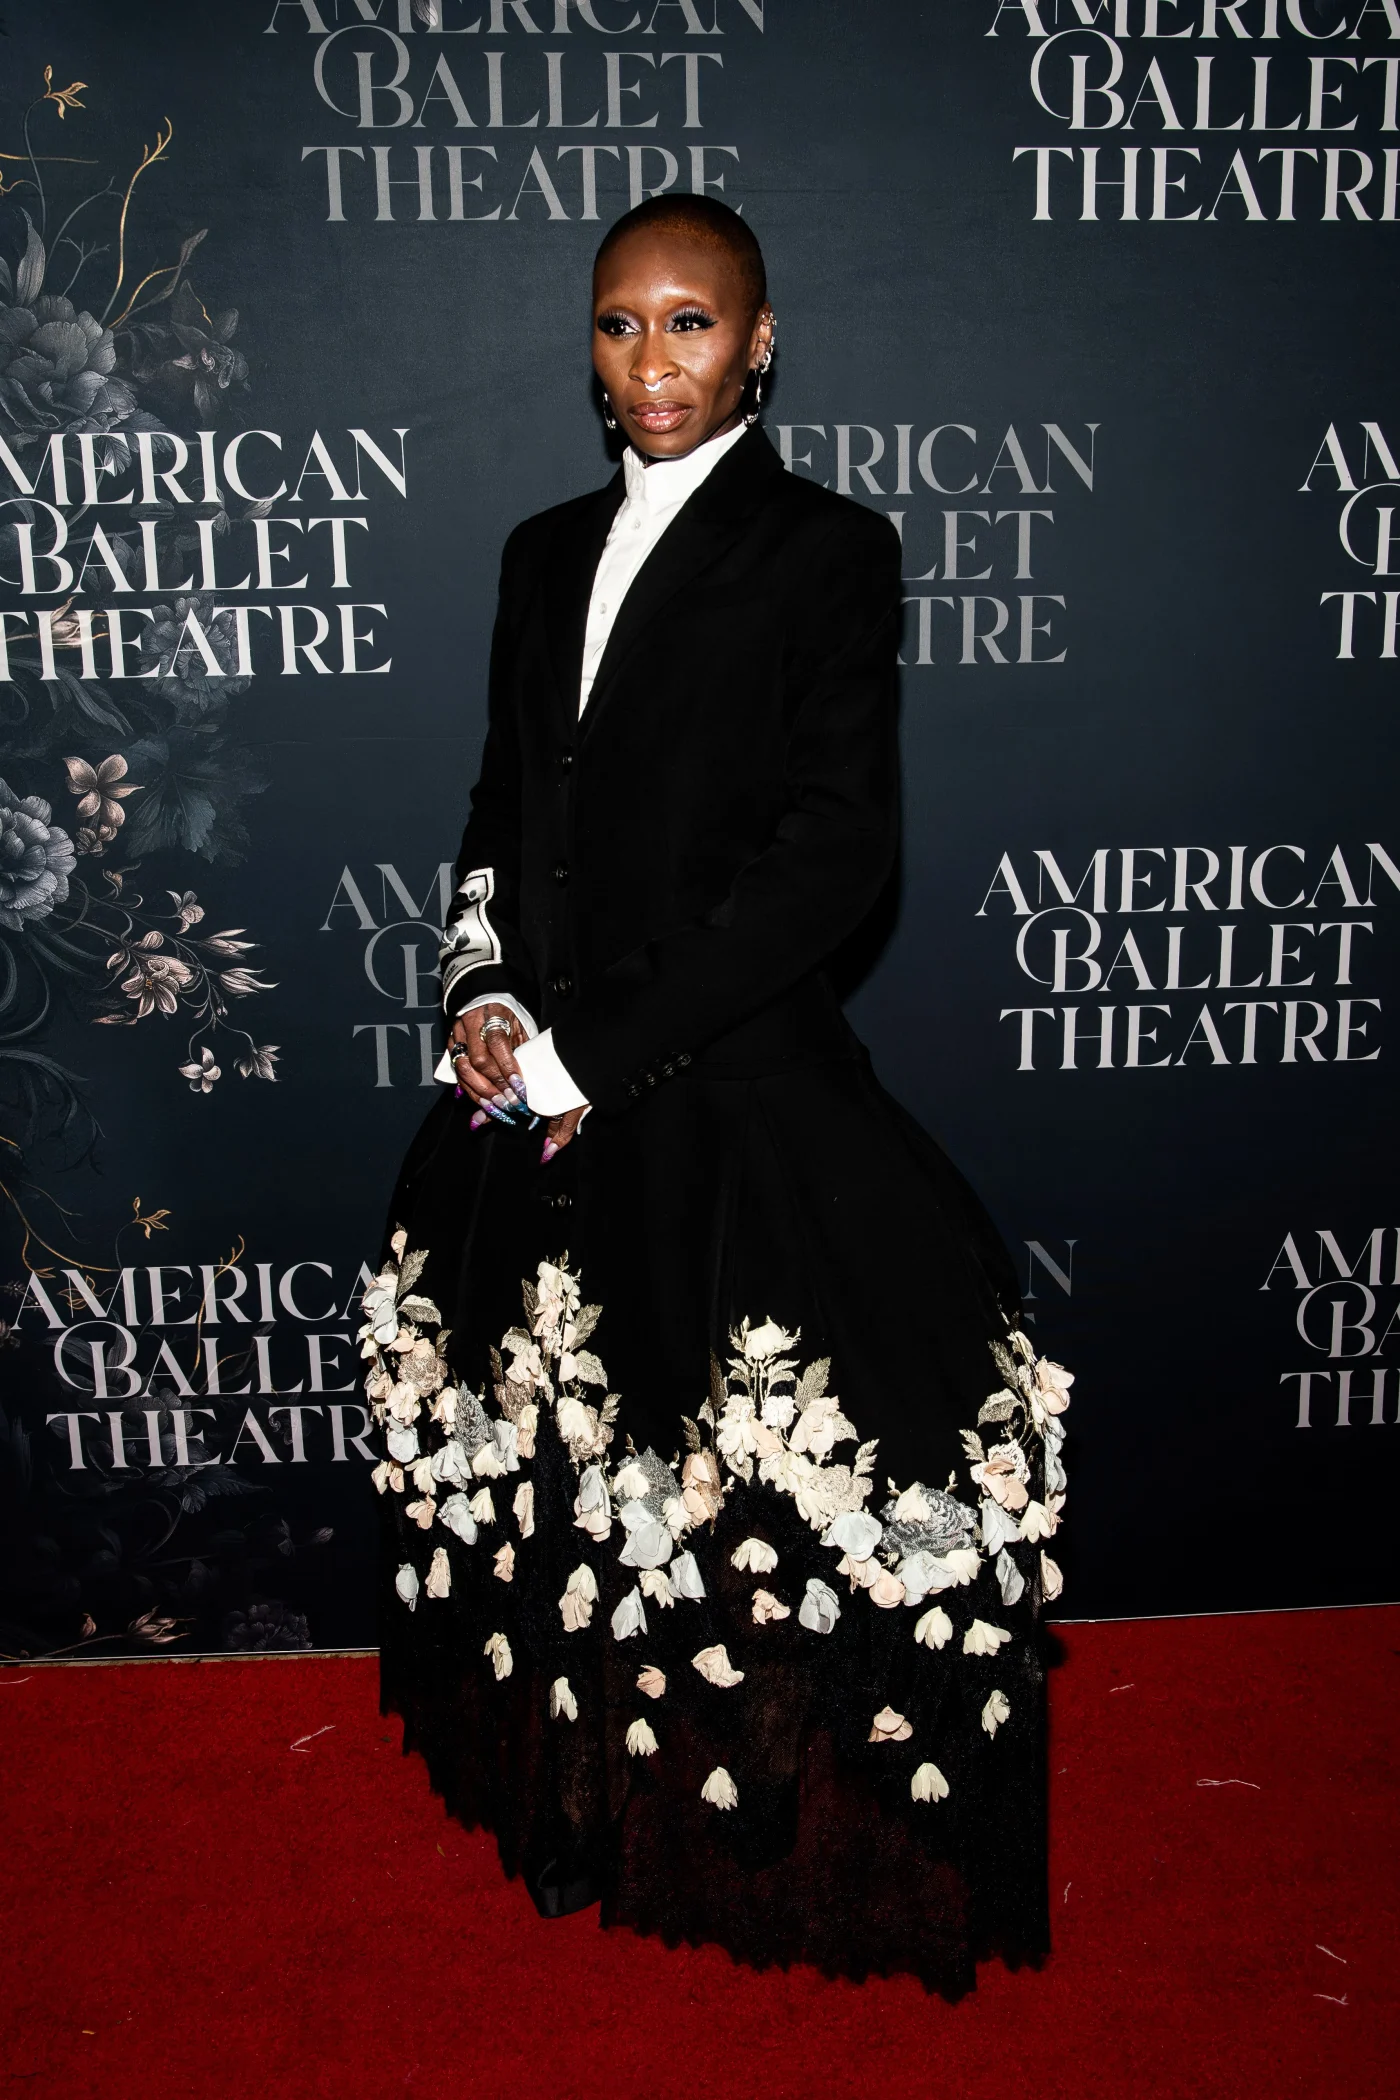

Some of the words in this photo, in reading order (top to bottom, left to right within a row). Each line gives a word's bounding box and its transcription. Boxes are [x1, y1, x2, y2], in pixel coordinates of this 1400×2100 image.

[314, 25, 724, 128] BALLET
[1031, 28, 1400, 131] BALLET
[301, 145, 743, 222] THEATRE
[764, 423, 1101, 495] ERICAN
[0, 498, 369, 594] BALLET
[897, 595, 1068, 665] TRE
[974, 843, 1400, 917] AMERICAN
[1016, 906, 1374, 993] BALLET
[999, 998, 1383, 1071] THEATRE
[1258, 1227, 1400, 1292] AM
[53, 1320, 364, 1399] BALLE
[1279, 1368, 1400, 1428] TH
